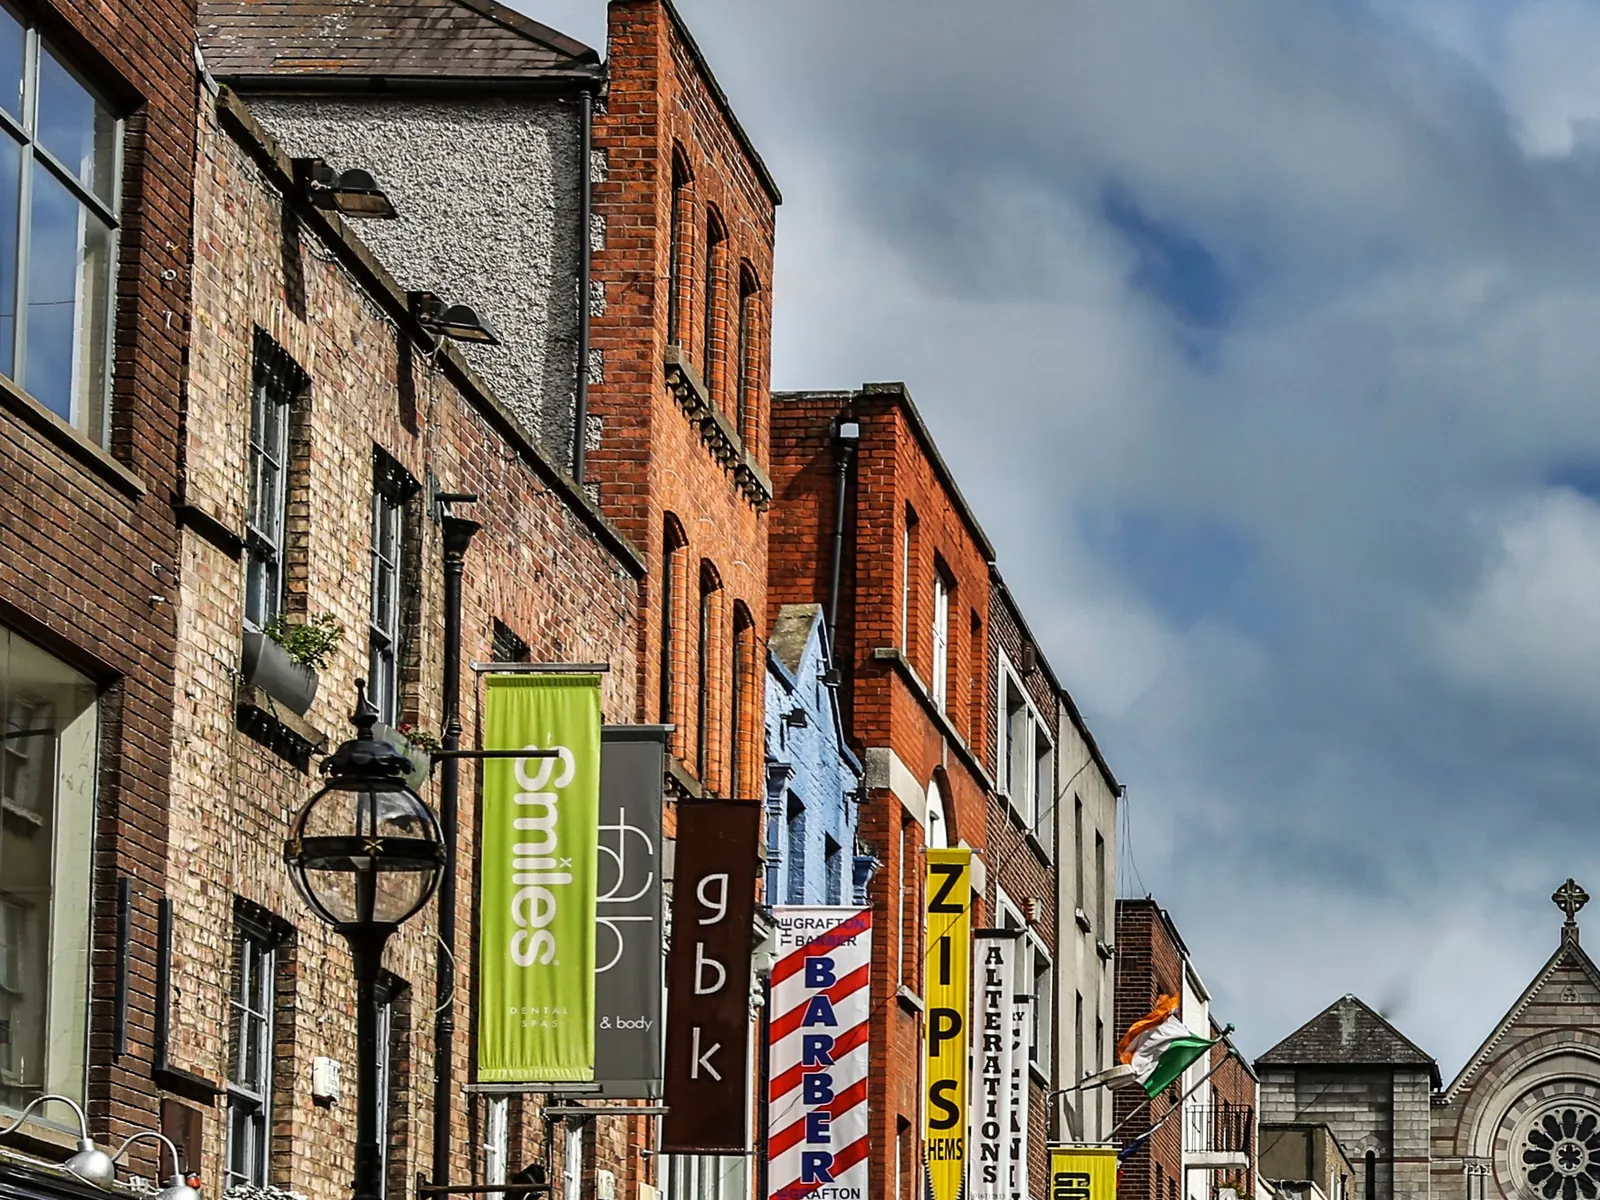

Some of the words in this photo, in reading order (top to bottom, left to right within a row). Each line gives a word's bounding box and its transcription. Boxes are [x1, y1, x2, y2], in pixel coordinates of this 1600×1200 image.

[510, 744, 575, 967] Smiles
[793, 918, 865, 929] GRAFTON
[795, 935, 857, 946] BARBER
[690, 872, 730, 1082] gbk
[927, 863, 965, 1132] ZIPS
[509, 1006, 569, 1015] DENTAL
[521, 1019, 560, 1028] SPAS
[600, 1016, 612, 1029] &
[616, 1015, 653, 1031] body
[800, 955, 838, 1184] BARBER
[982, 945, 1004, 1184] ALTERATIONS
[927, 1137, 964, 1162] HEMS
[792, 1188, 860, 1200] GRAFTON
